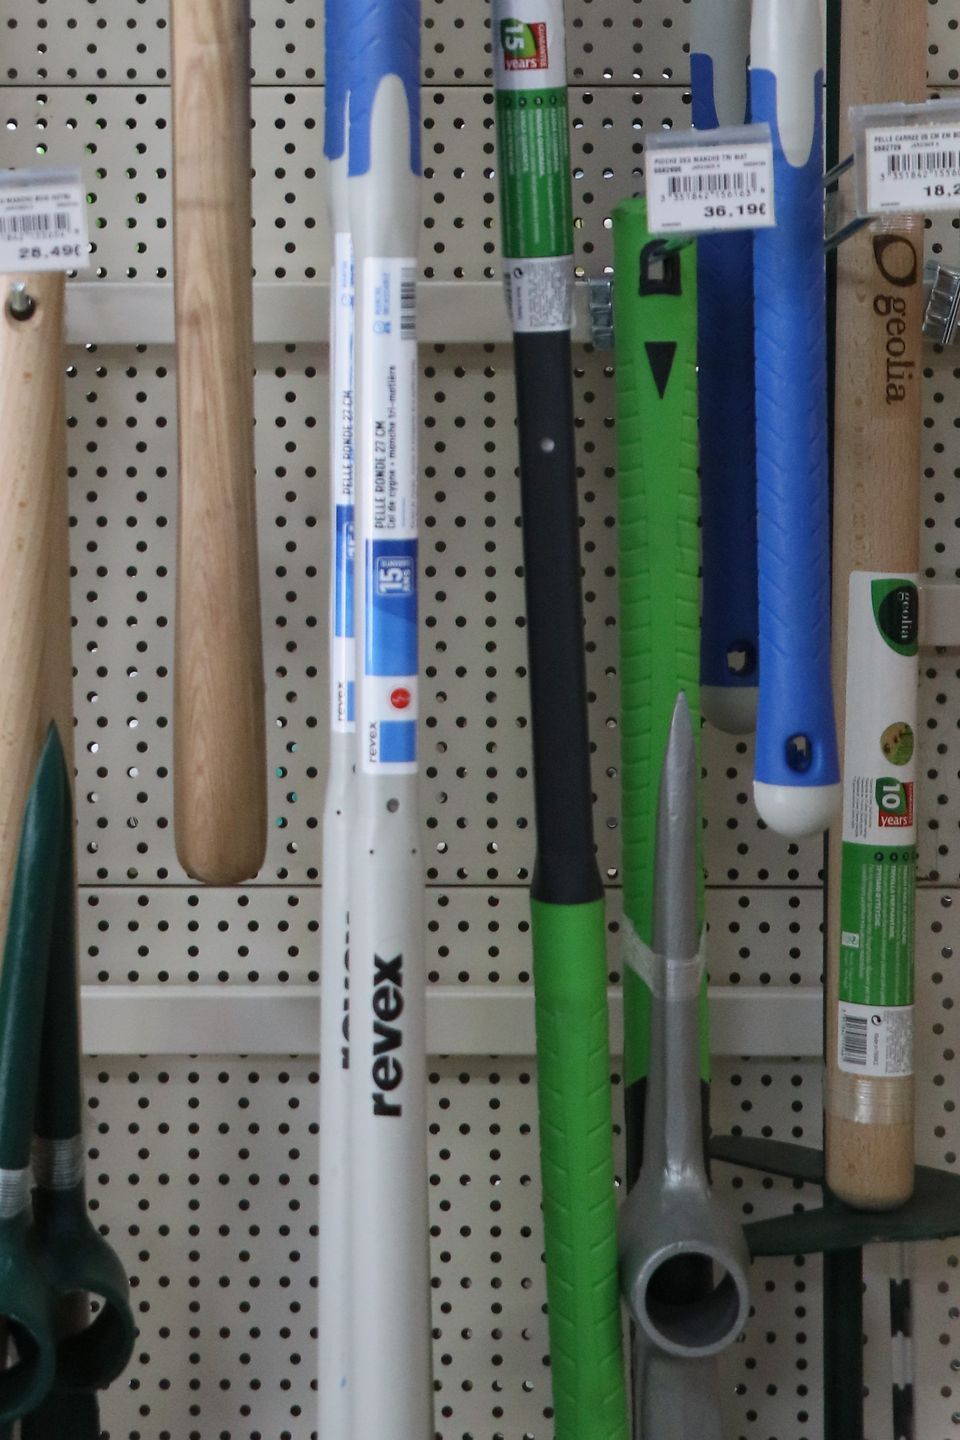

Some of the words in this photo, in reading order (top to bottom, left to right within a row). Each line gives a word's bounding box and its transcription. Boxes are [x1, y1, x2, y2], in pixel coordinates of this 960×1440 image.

[505, 23, 525, 49] 15
[506, 58, 537, 69] years
[873, 294, 916, 405] geolia
[375, 420, 386, 437] CM
[387, 422, 396, 458] manche
[375, 441, 386, 453] 27
[375, 458, 386, 493] RONDE
[388, 470, 398, 498] cygne
[375, 497, 386, 529] PELLE
[387, 501, 395, 512] de
[380, 567, 403, 593] 15
[898, 591, 912, 640] geolia
[368, 721, 377, 762] revex
[882, 783, 901, 809] 10
[880, 815, 907, 827] years
[372, 953, 404, 1117] revex
